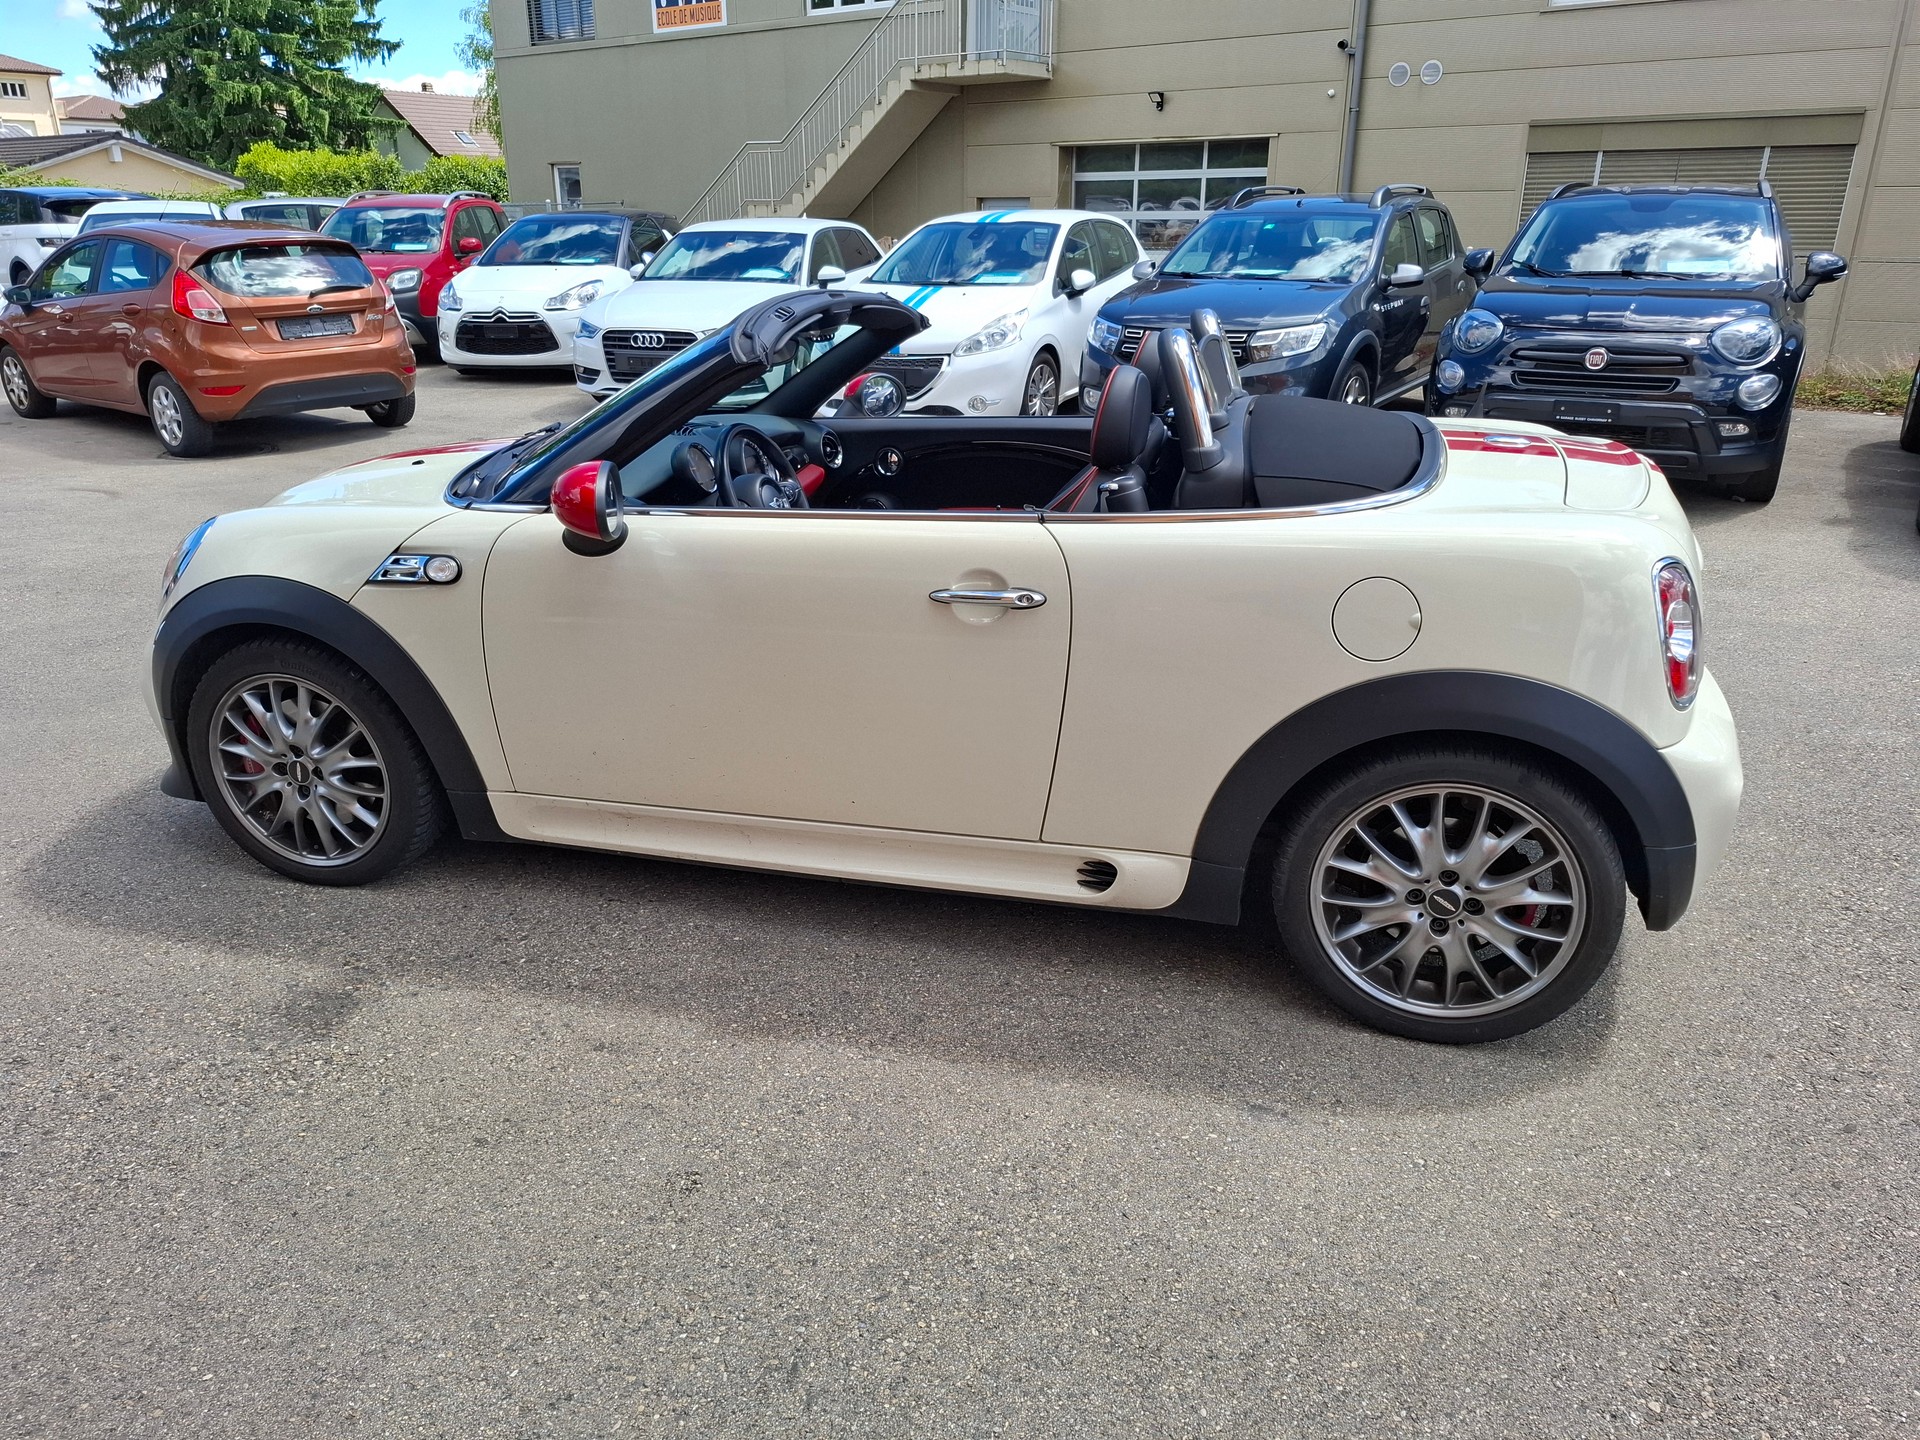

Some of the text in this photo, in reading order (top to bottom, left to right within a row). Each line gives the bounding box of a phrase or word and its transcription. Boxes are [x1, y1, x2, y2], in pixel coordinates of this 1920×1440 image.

[657, 4, 721, 27] ECOLE DE MUSIQUE
[1381, 299, 1404, 312] STEPWAY
[1589, 354, 1603, 365] FIAT
